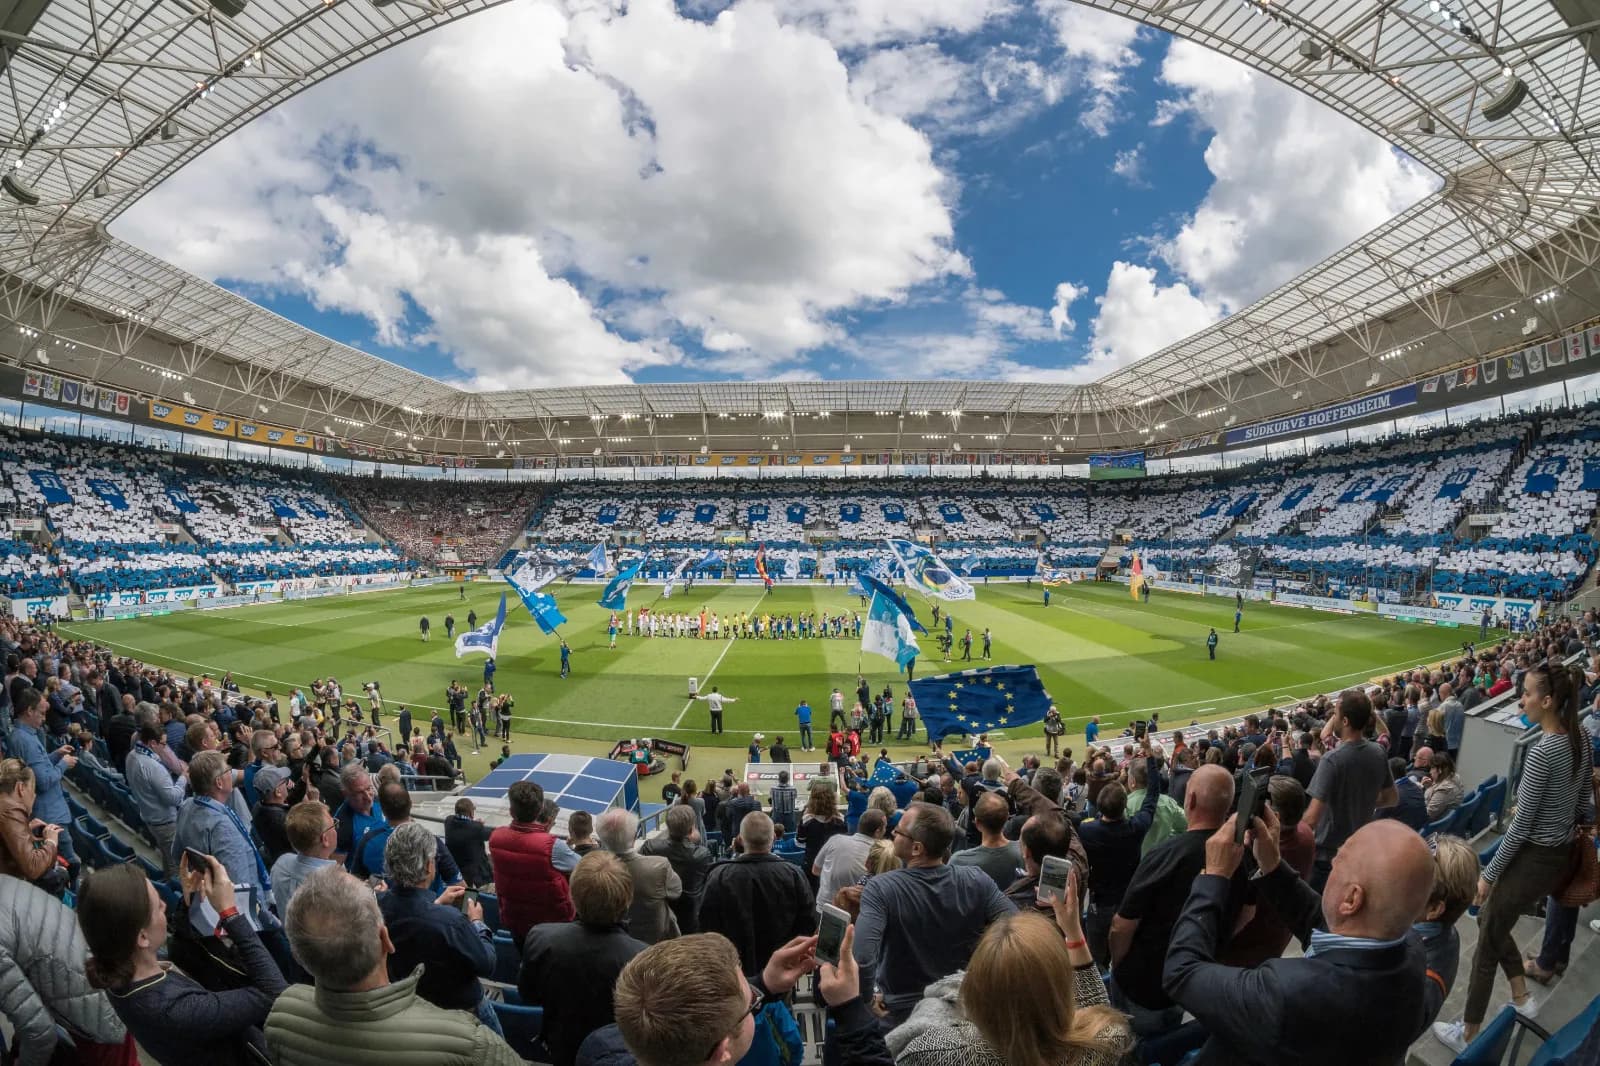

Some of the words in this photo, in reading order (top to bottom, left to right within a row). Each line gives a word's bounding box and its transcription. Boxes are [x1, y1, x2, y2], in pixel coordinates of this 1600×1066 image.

[1245, 416, 1306, 439] SÜDKURVE
[1308, 394, 1391, 426] HOFFENHEIM
[120, 596, 137, 605] SAP
[148, 593, 165, 603] SAP
[175, 591, 191, 600] SAP
[1438, 599, 1457, 610] SAP
[1505, 604, 1527, 618] SAP
